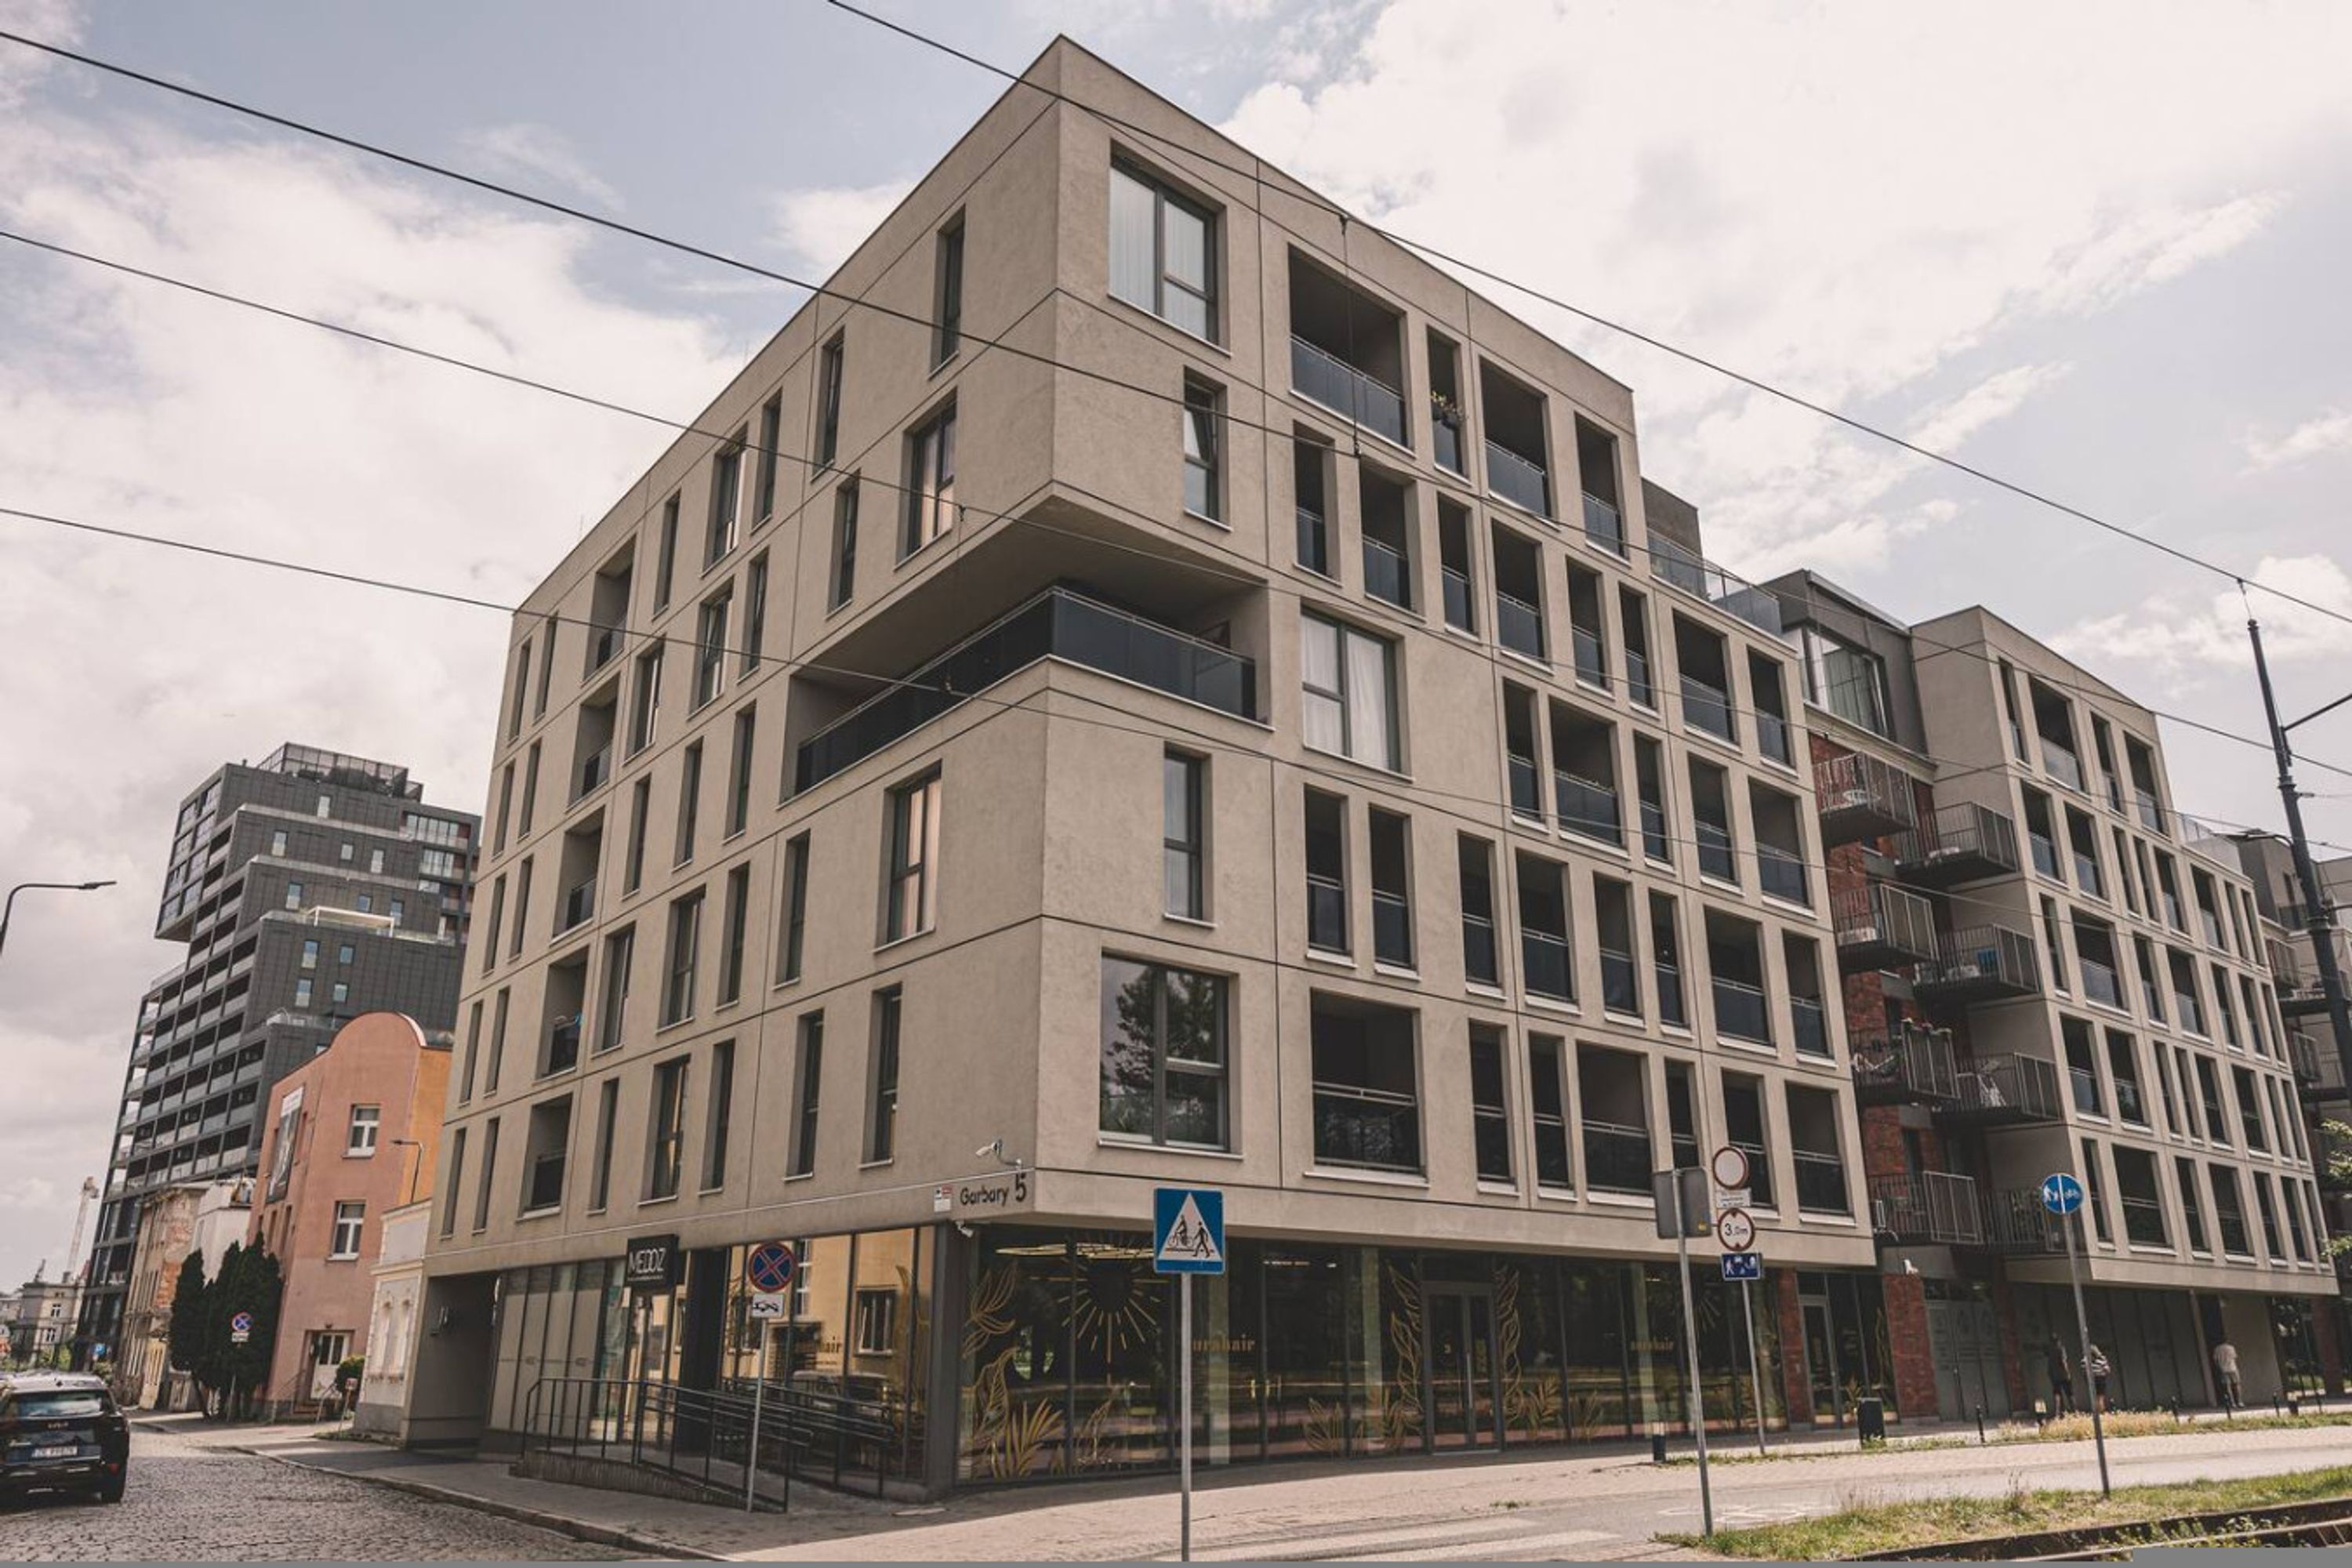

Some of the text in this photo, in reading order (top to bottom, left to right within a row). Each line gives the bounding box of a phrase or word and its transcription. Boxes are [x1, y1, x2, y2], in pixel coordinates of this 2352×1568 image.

[960, 1174, 1027, 1207] Garbary 5
[628, 1247, 666, 1273] MEDOZ
